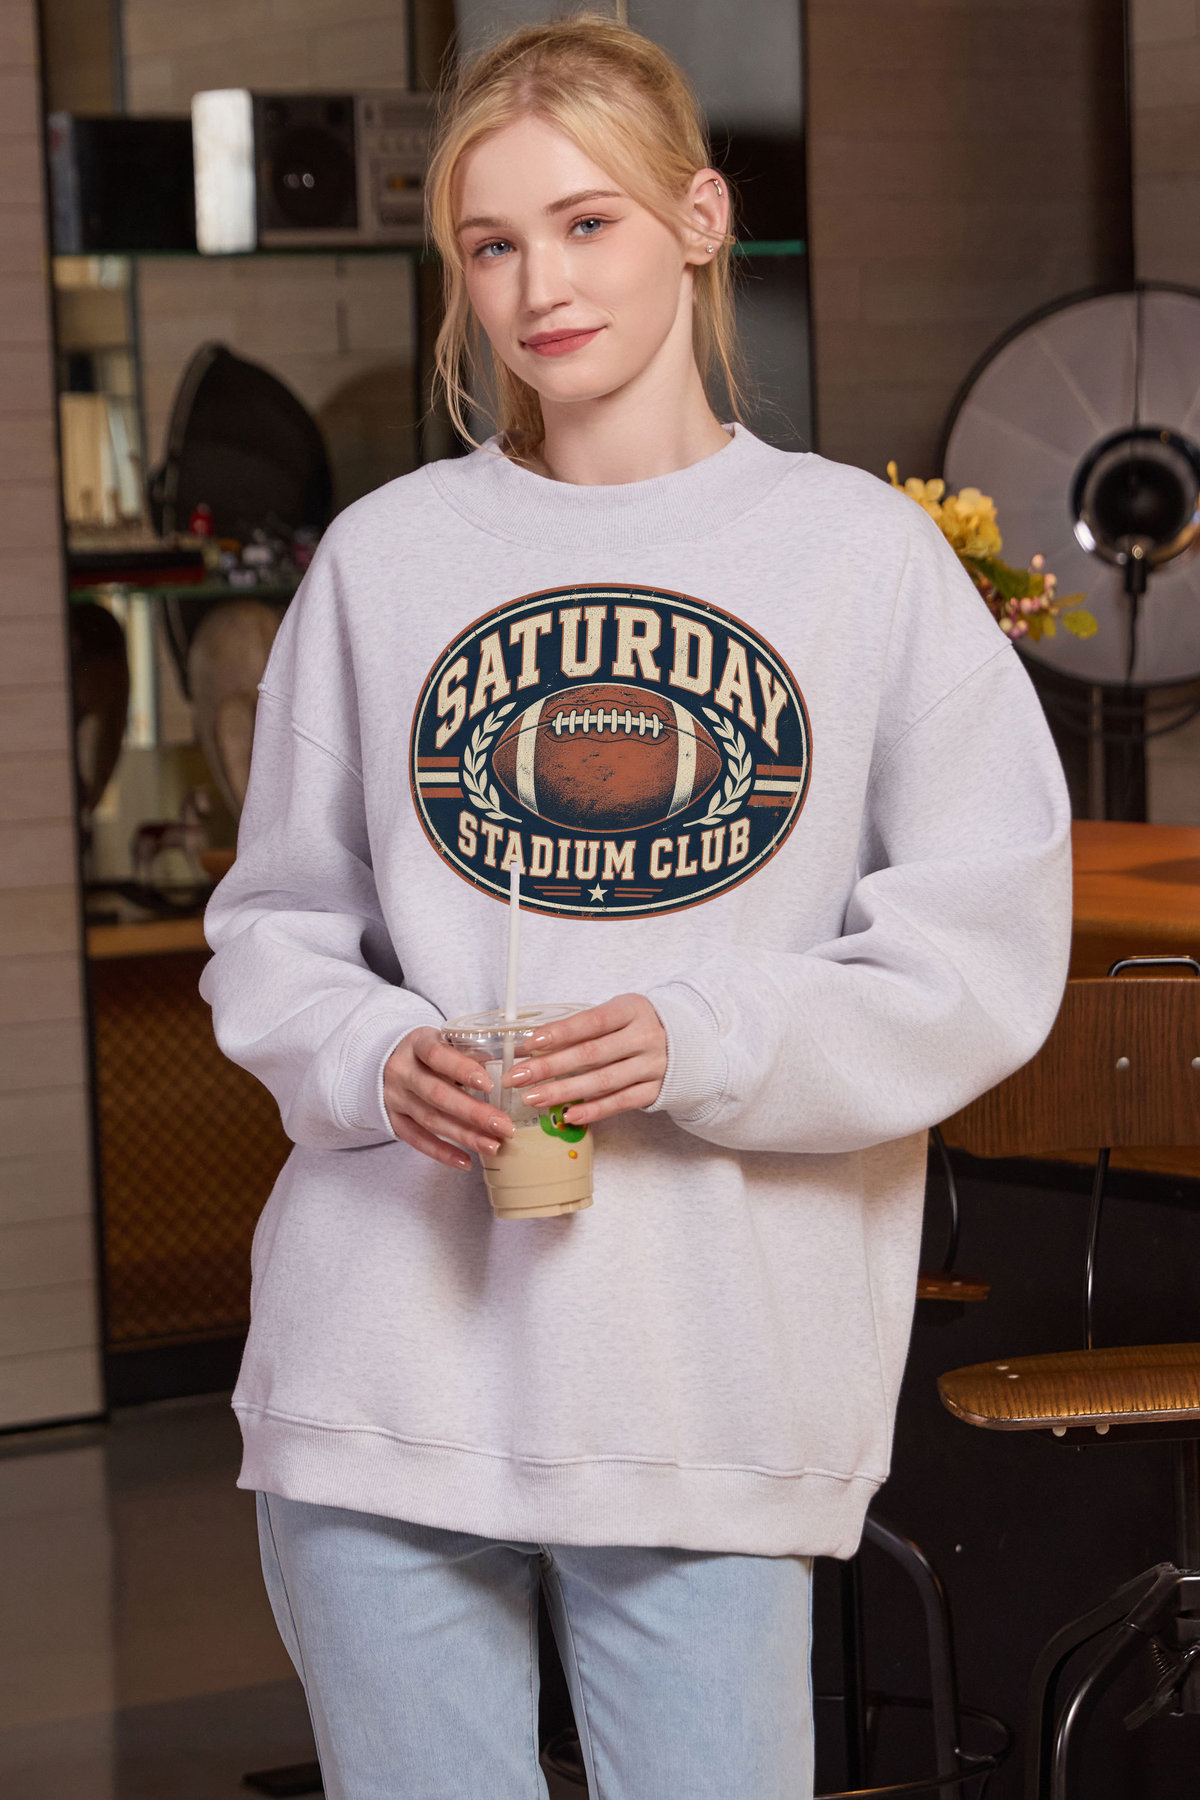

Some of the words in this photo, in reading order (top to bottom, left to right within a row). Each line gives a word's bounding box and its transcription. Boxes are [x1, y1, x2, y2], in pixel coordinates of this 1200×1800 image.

[435, 605, 788, 756] SATURDAY
[458, 810, 637, 880] STADIUM
[649, 817, 750, 880] CLUB
